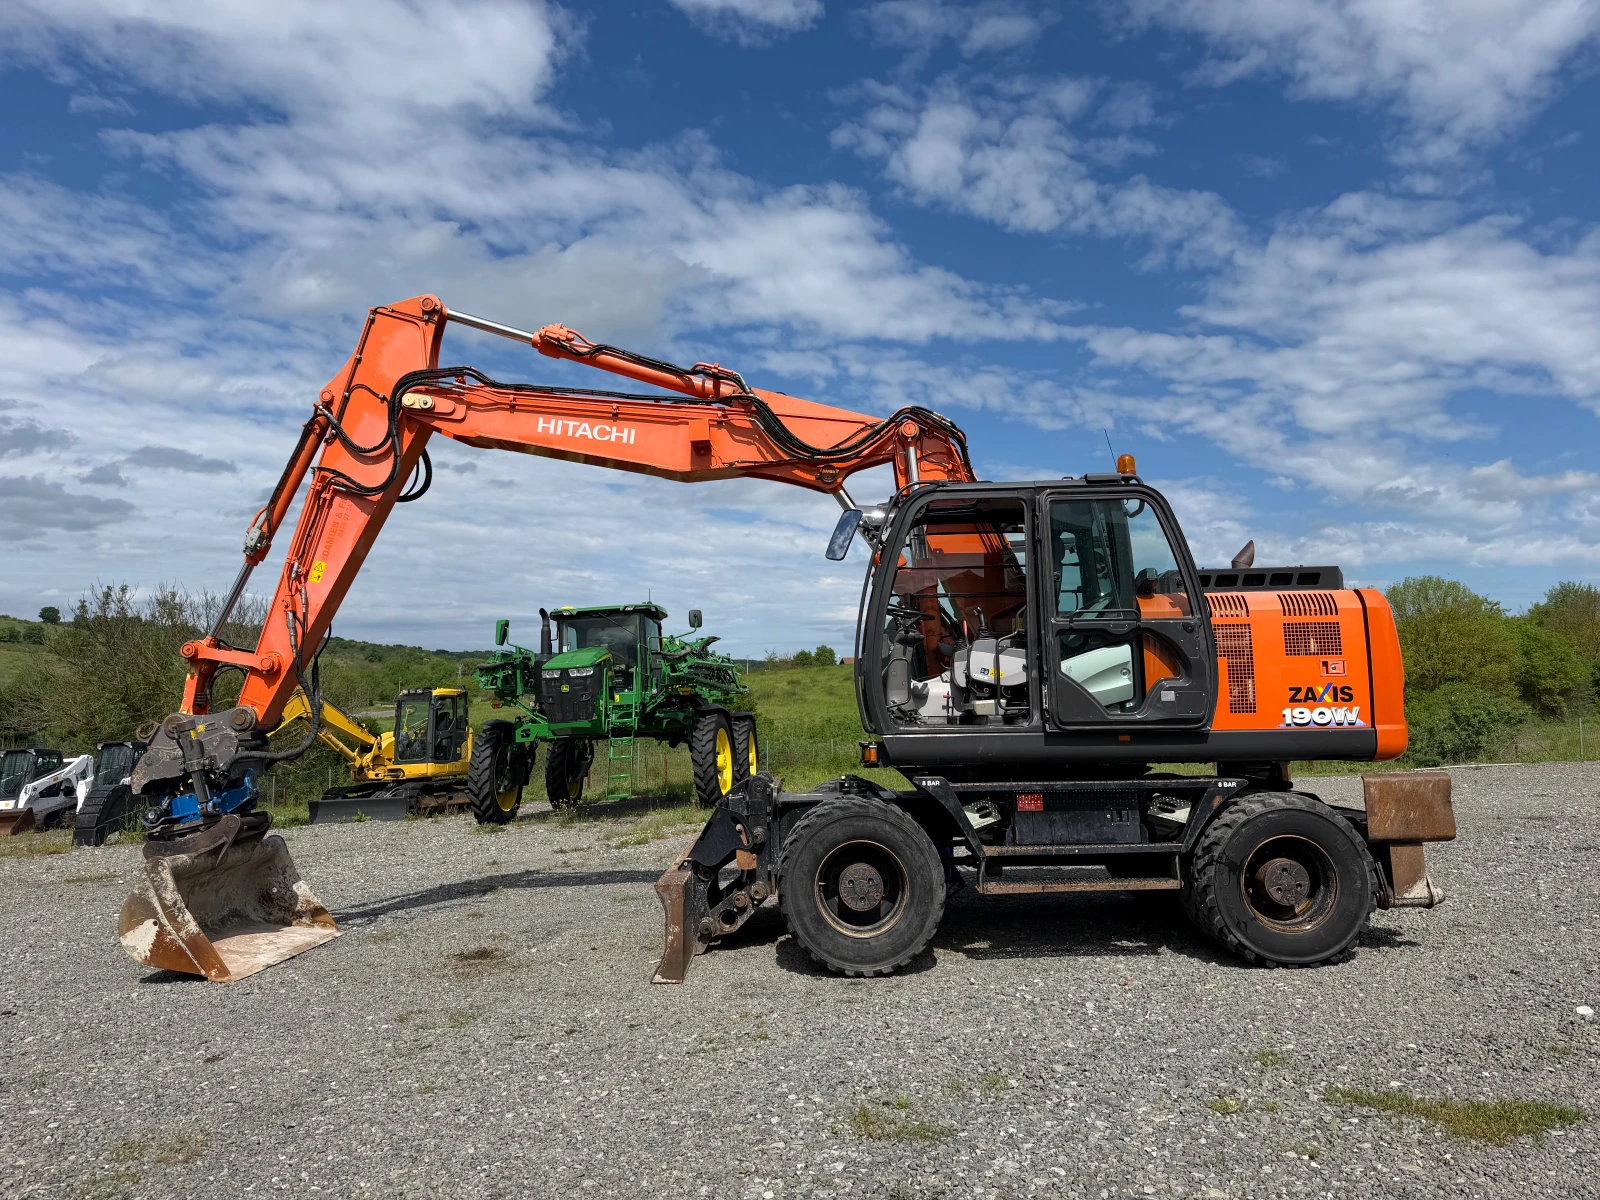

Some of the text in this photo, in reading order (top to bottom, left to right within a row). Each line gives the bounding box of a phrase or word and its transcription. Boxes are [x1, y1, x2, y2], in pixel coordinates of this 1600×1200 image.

[537, 417, 636, 444] HITACHI
[1288, 682, 1354, 703] ZAXIS
[1282, 706, 1360, 727] 190W
